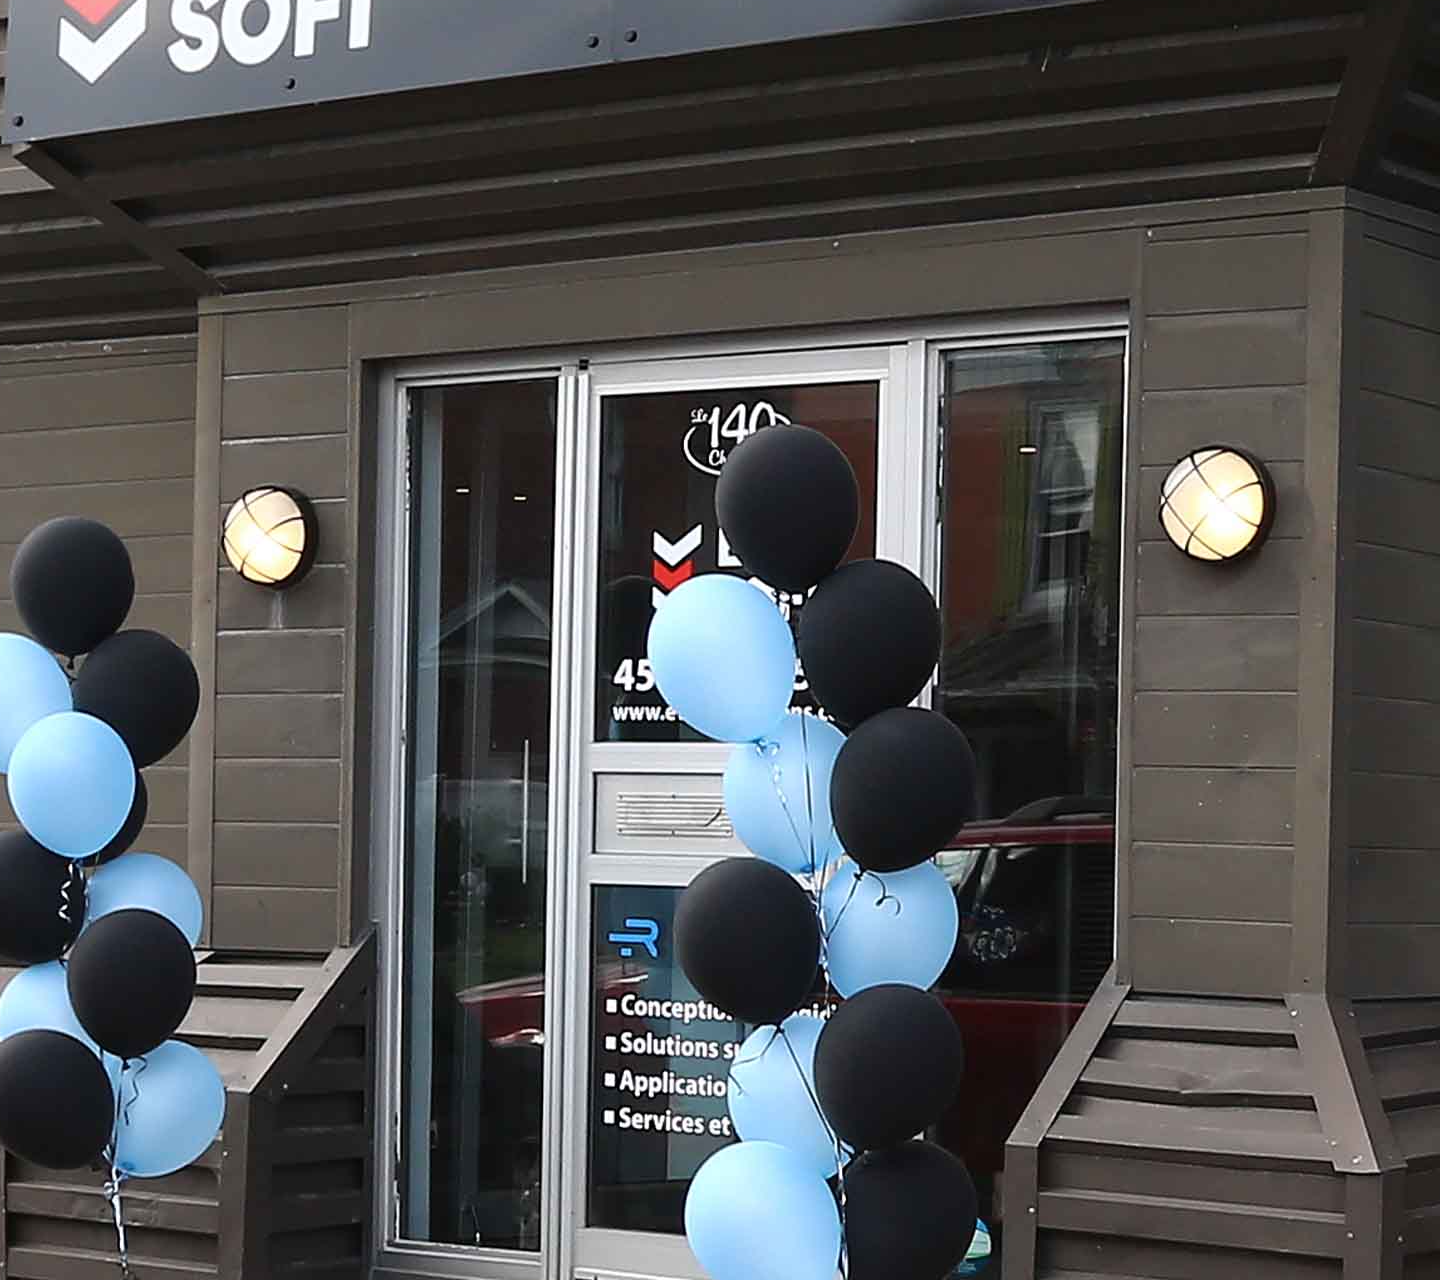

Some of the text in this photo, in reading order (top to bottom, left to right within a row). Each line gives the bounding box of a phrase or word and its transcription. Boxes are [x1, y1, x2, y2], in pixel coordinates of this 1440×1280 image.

[708, 401, 776, 448] 140
[620, 1032, 719, 1059] Solutions
[619, 1070, 727, 1098] Applicatio
[618, 1107, 731, 1136] Services et
